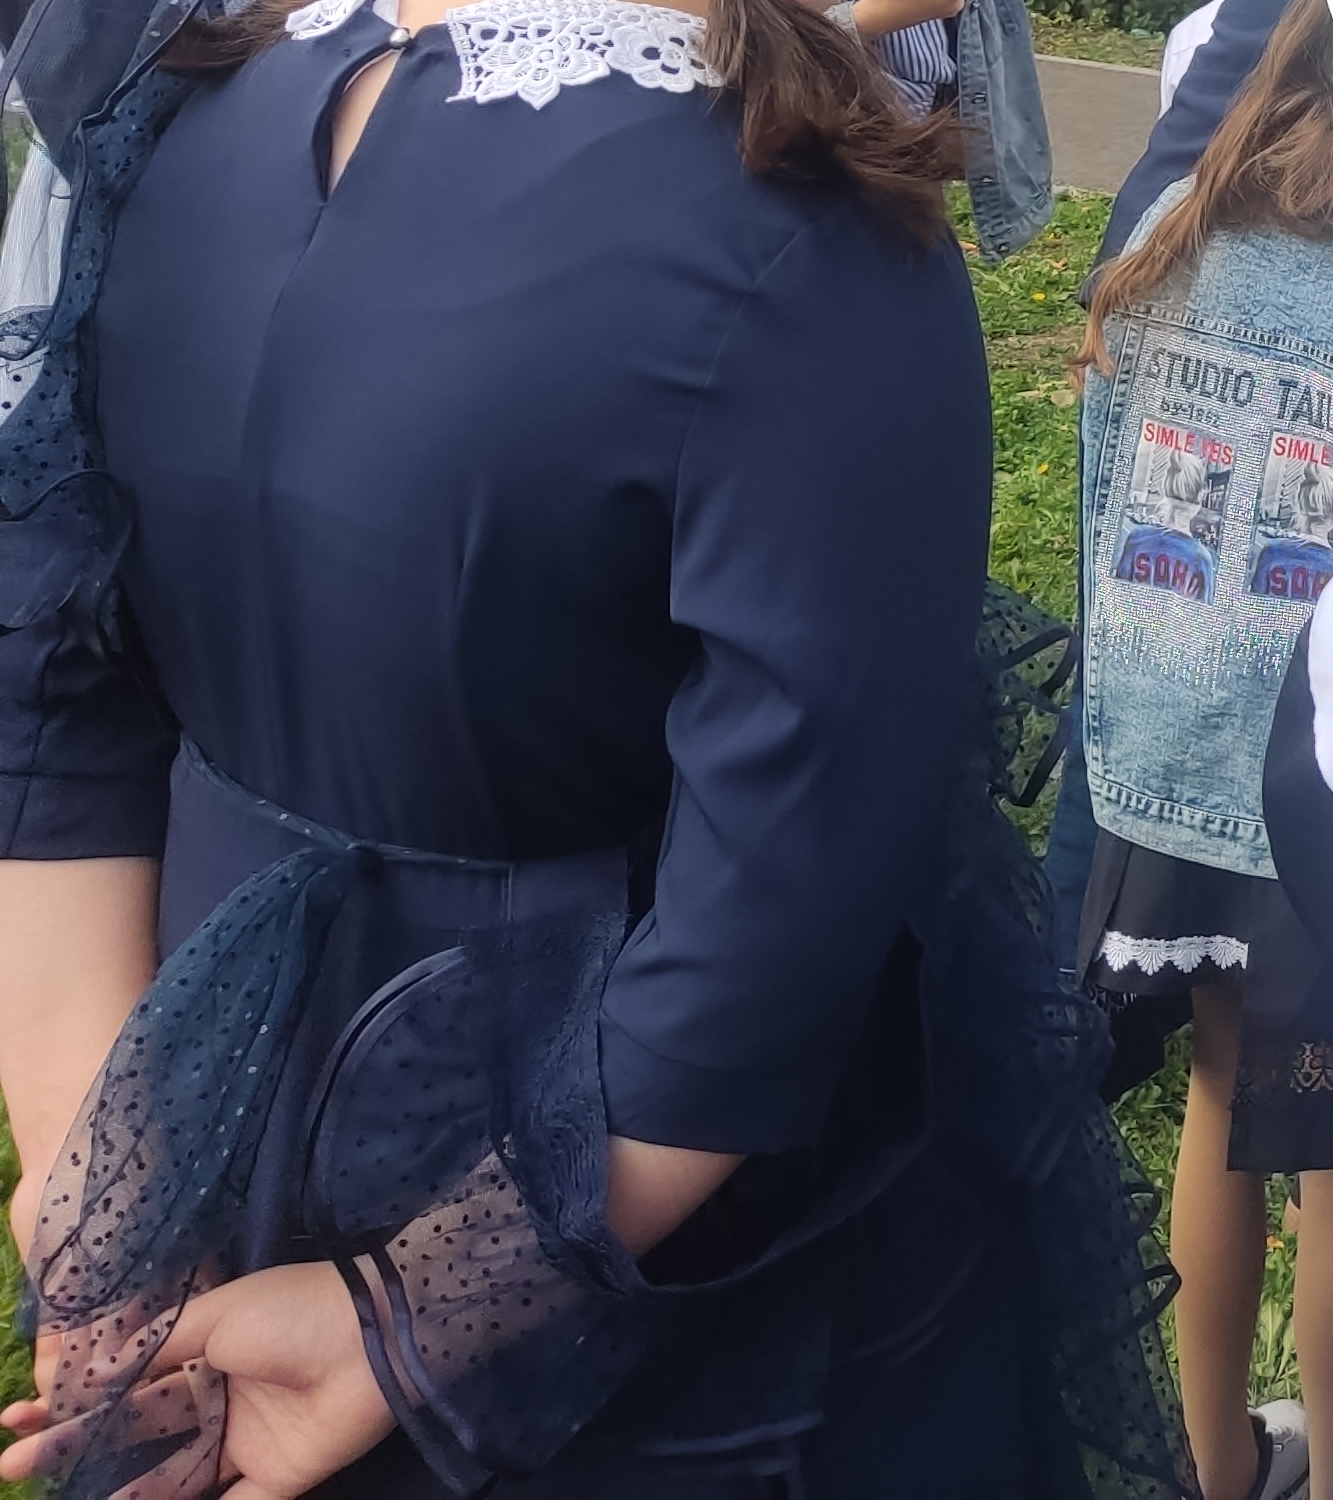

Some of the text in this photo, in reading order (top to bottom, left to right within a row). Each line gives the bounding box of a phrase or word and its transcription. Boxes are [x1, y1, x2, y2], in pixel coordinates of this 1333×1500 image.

[1143, 348, 1255, 408] STUDIO
[1143, 422, 1197, 455] SIMLE
[1273, 436, 1332, 467] SIMLE
